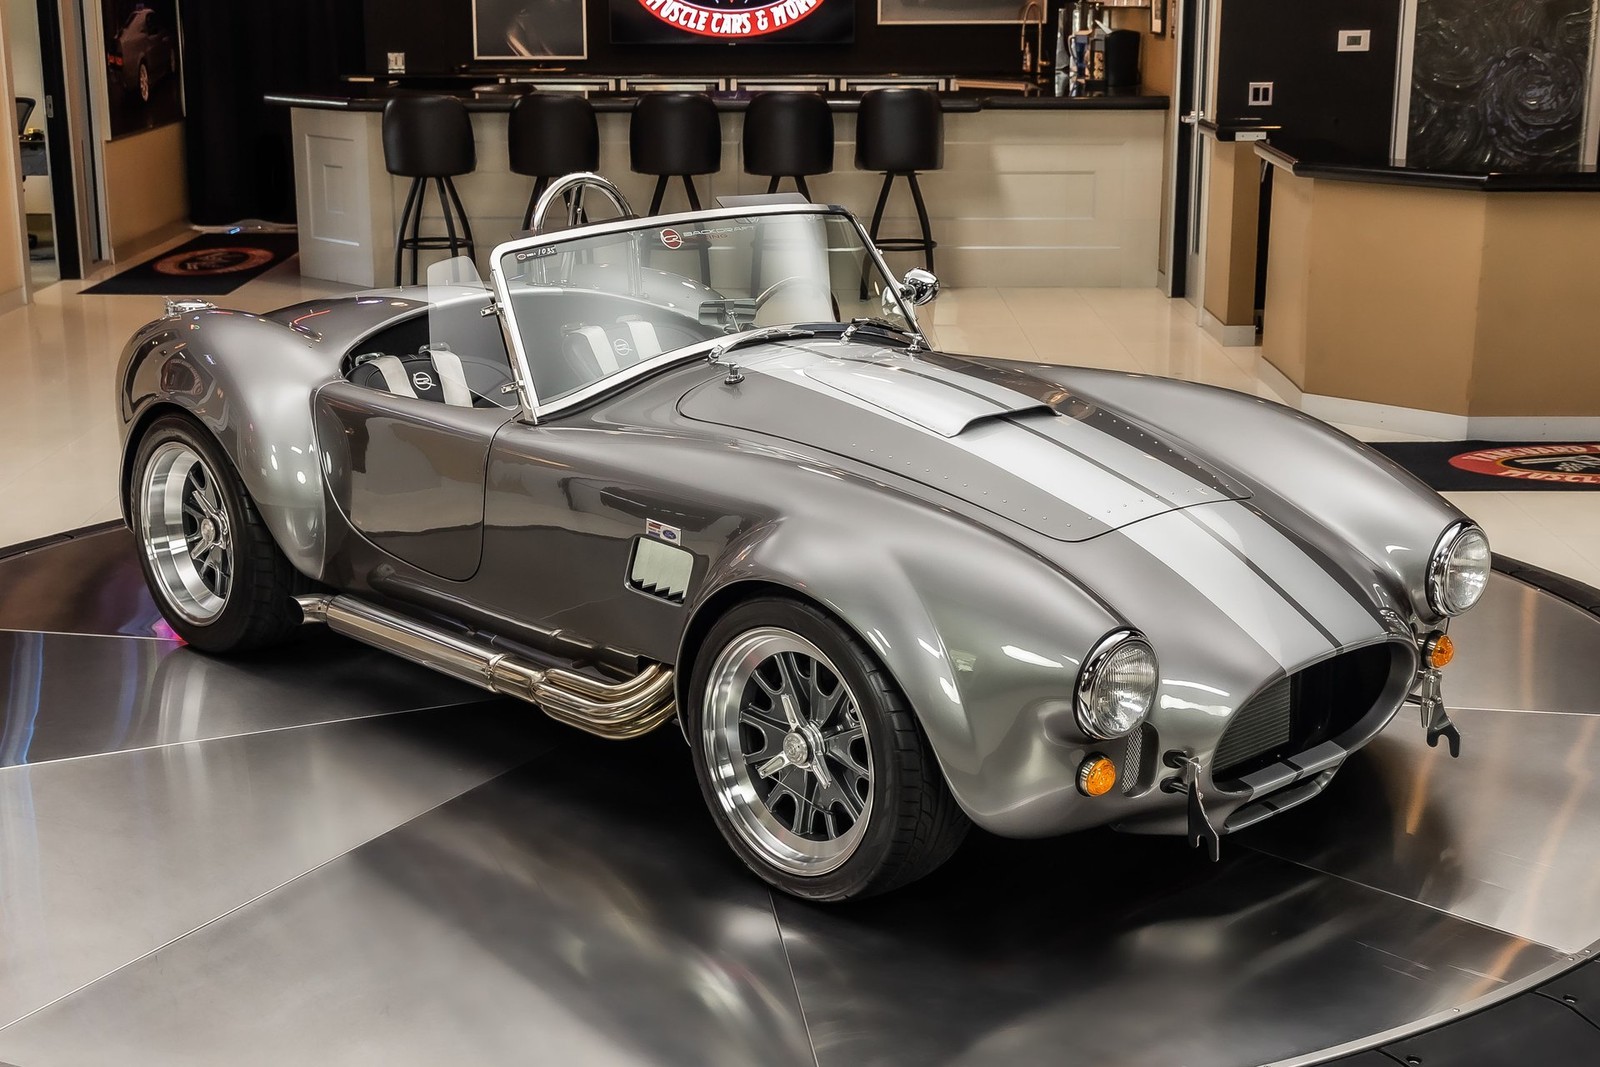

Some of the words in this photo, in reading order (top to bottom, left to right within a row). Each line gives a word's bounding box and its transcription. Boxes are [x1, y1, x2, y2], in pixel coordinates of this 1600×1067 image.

[711, 13, 751, 34] CARS
[753, 10, 769, 31] &
[770, 0, 817, 27] MOR
